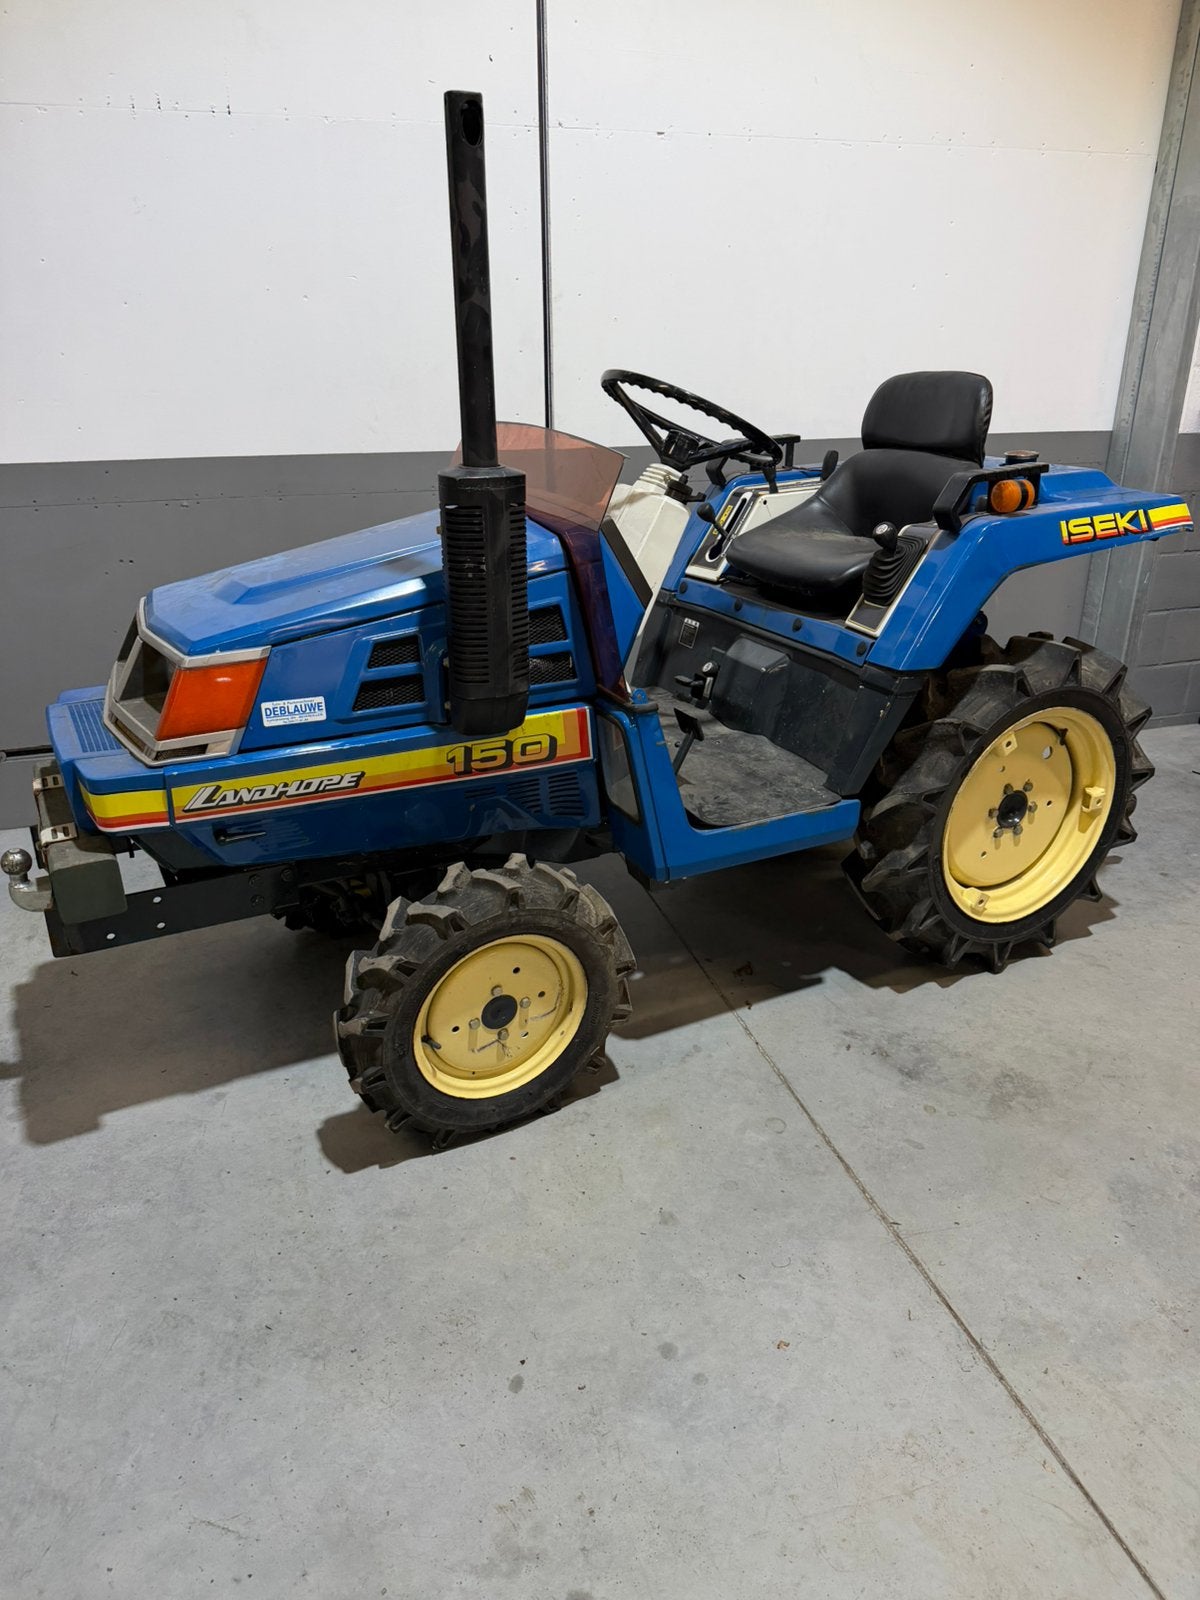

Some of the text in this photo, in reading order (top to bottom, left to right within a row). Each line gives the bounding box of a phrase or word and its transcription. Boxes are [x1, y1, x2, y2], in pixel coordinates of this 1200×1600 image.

[1060, 509, 1149, 545] ISEKI
[264, 702, 324, 717] DEBLAUWE
[446, 733, 557, 776] 150
[183, 771, 365, 812] LANDHOPE
